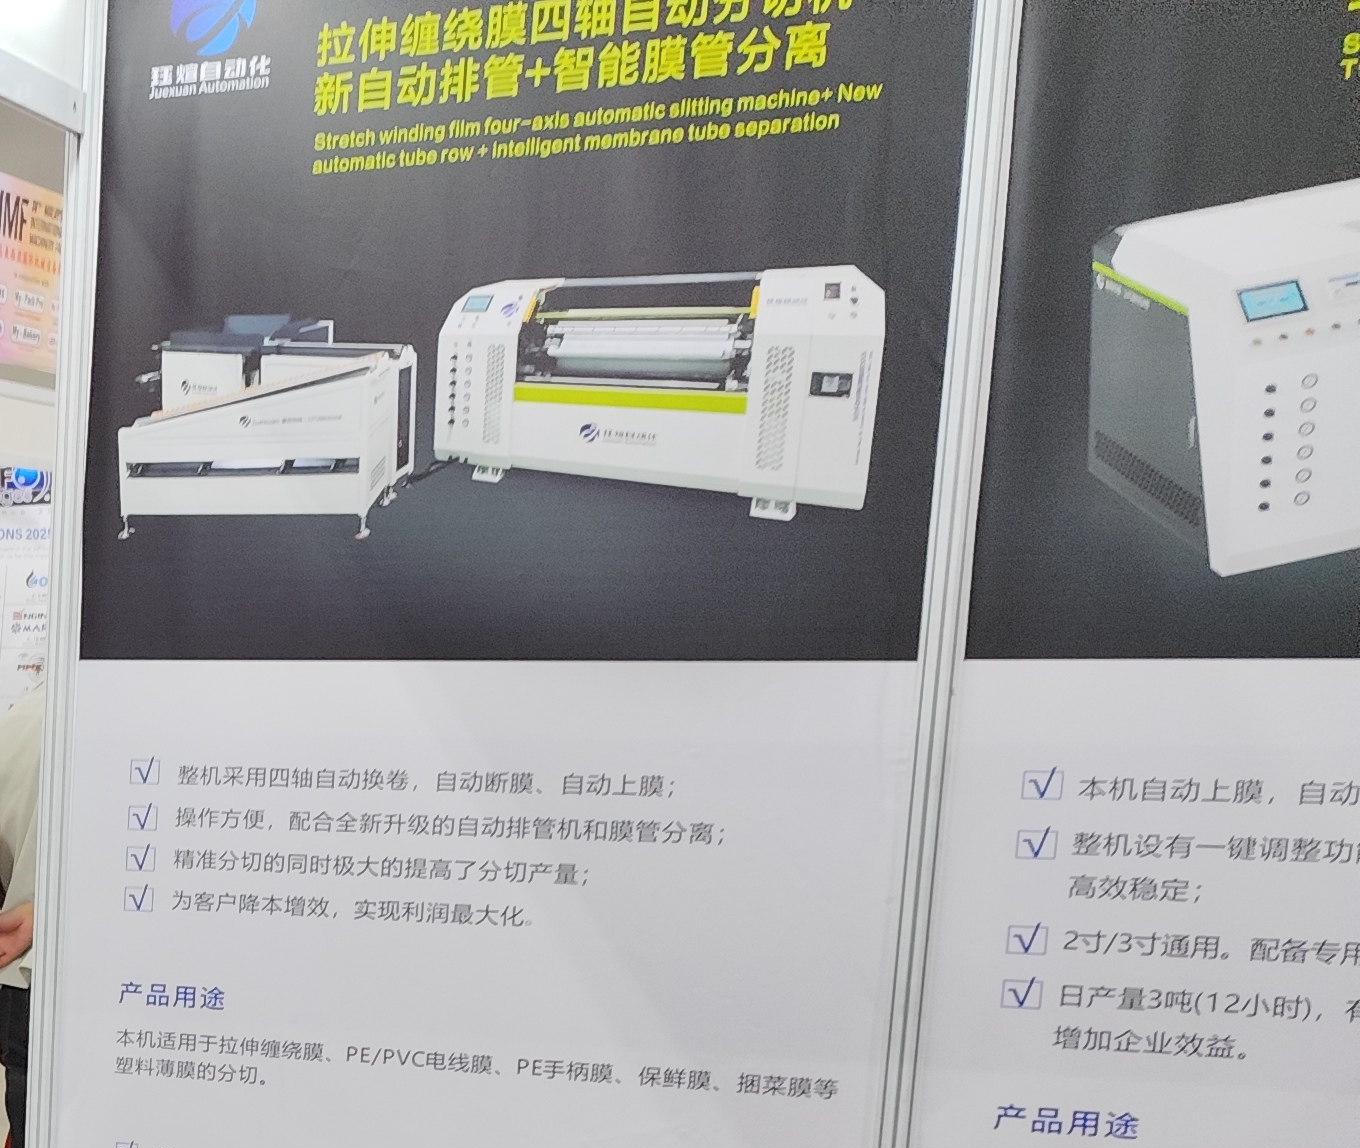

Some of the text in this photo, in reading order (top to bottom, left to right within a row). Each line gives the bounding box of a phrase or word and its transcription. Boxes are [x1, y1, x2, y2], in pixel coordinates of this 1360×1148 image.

[312, 21, 831, 116] 新自动排管+智能膜管分离
[148, 75, 270, 101] Juexuan Automation
[313, 81, 884, 152] Stretch winding film four-axis automatic slitting machine+ New
[311, 110, 841, 175] automatic tube row + intelligent membrane tube separation
[1071, 831, 1360, 865] 整机设有一键调整功
[118, 980, 226, 1011] 产品用途
[993, 1103, 1140, 1141] 产品用途
